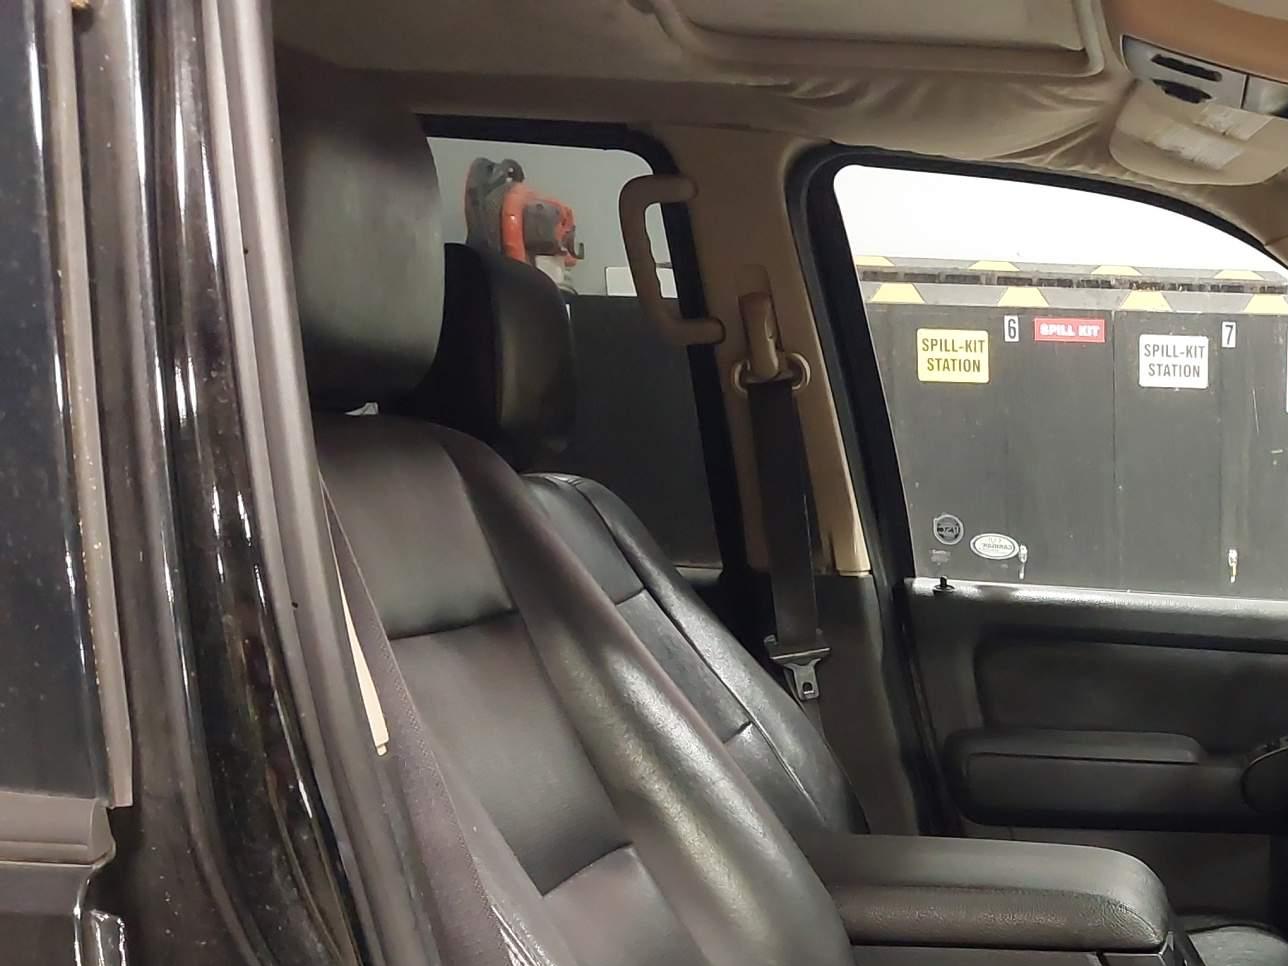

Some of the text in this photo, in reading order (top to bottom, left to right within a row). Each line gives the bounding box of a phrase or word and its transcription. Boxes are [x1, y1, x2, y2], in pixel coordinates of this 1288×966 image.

[1007, 318, 1016, 339] 6
[1039, 322, 1101, 336] SPILL KIT
[1225, 324, 1234, 345] 7
[921, 338, 986, 353] SPILL-KIT
[1143, 343, 1206, 359] SPILL-KIT
[927, 357, 981, 373] STATION
[1148, 362, 1201, 378] STATION
